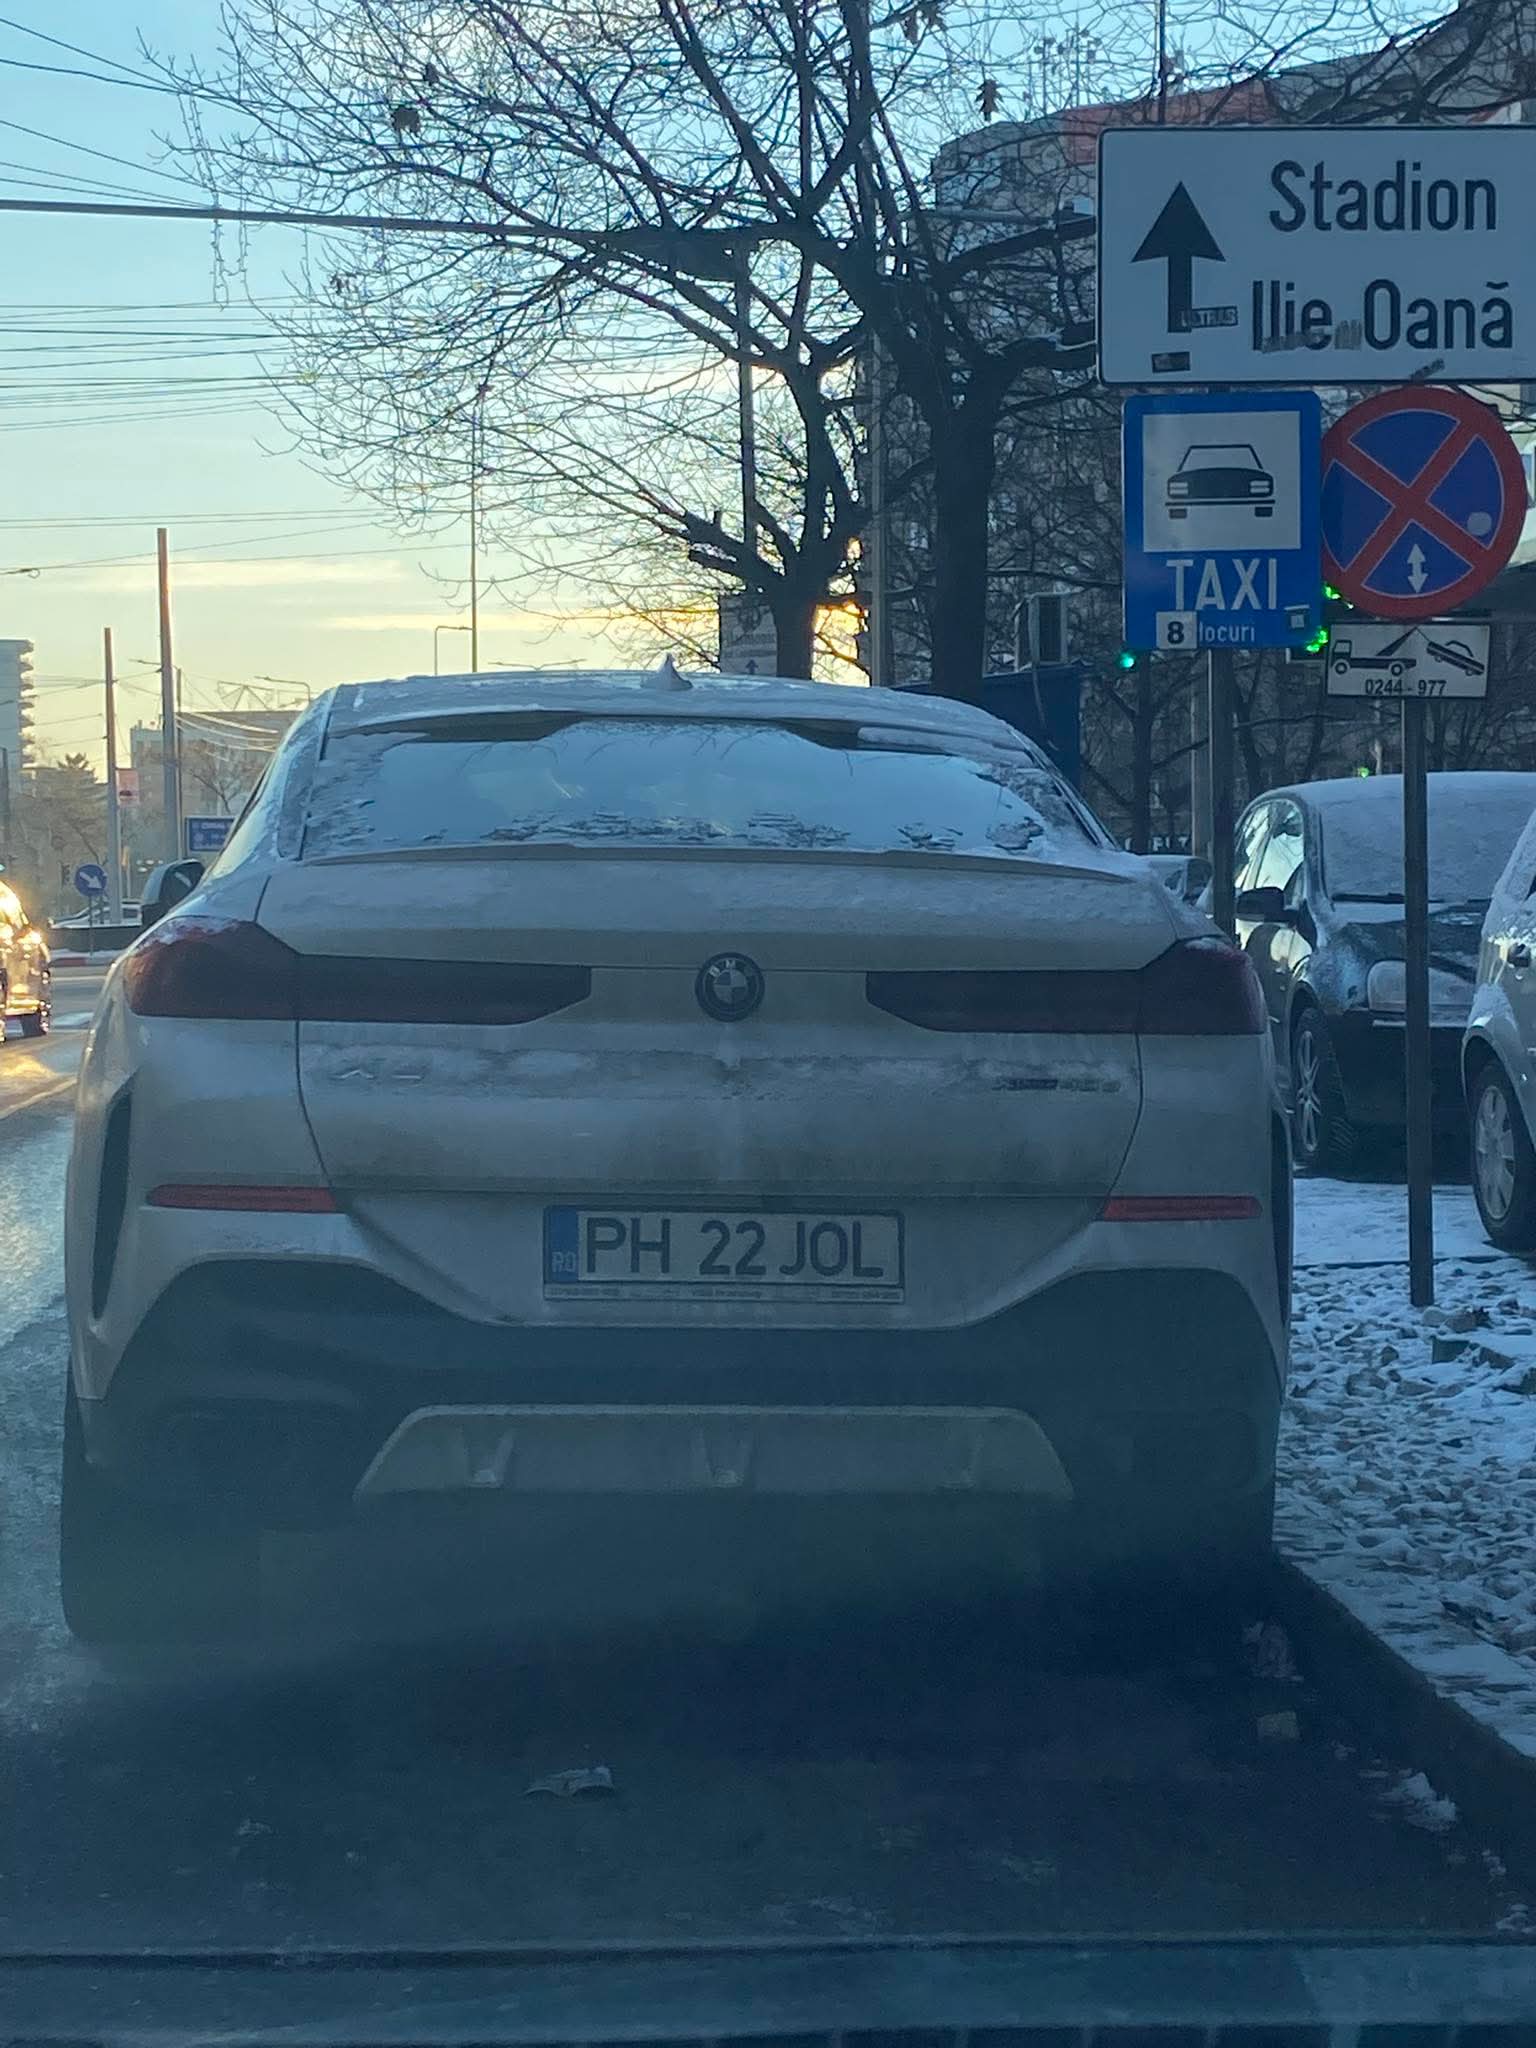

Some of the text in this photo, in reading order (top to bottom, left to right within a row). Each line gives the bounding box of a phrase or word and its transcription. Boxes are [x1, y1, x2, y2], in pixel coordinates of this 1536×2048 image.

[1269, 159, 1497, 233] Stadion
[1252, 278, 1514, 351] Ilie Oană
[1165, 557, 1278, 611] TAXI
[1166, 620, 1256, 645] 8 locuri
[1364, 678, 1403, 695] 0244
[1417, 679, 1448, 696] 977
[551, 1250, 577, 1273] RO
[586, 1216, 884, 1279] PH 22 JOL
